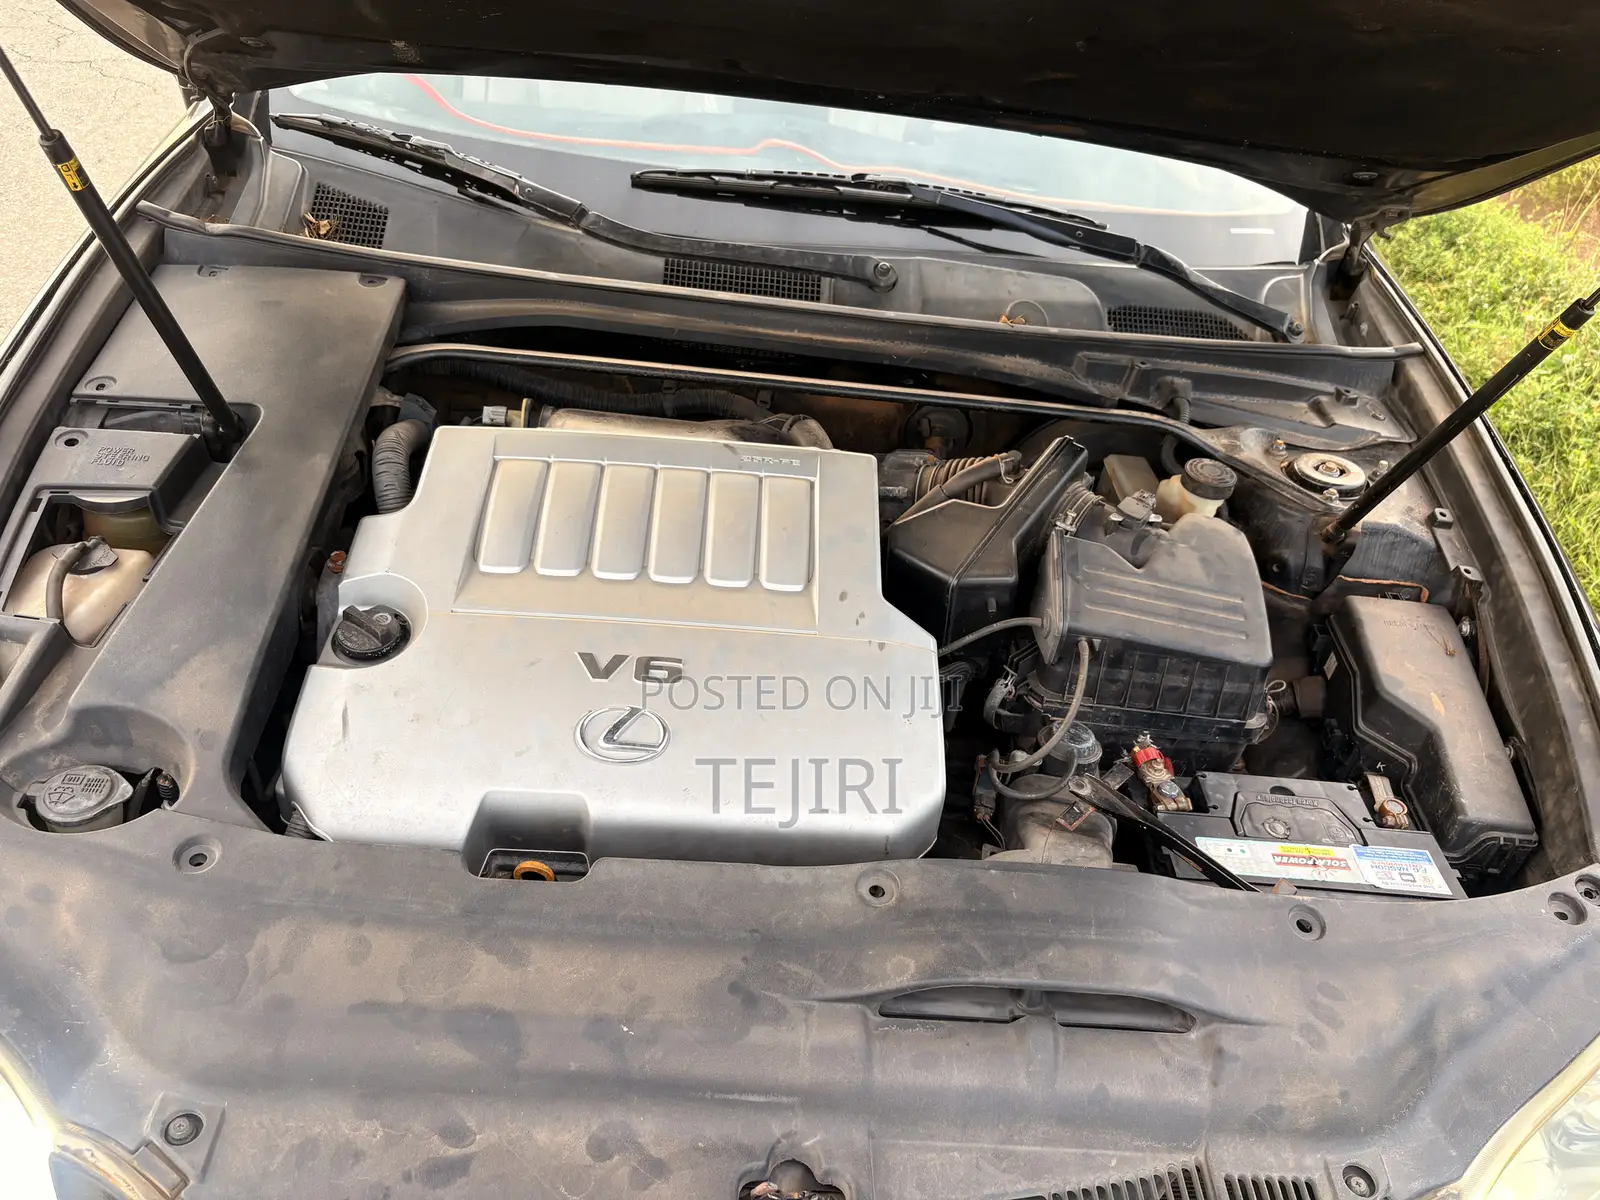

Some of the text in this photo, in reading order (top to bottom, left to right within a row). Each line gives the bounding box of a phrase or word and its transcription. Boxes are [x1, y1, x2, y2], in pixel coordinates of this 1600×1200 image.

[98, 446, 136, 454] POWER
[95, 452, 151, 462] STEERING
[573, 651, 685, 684] V6
